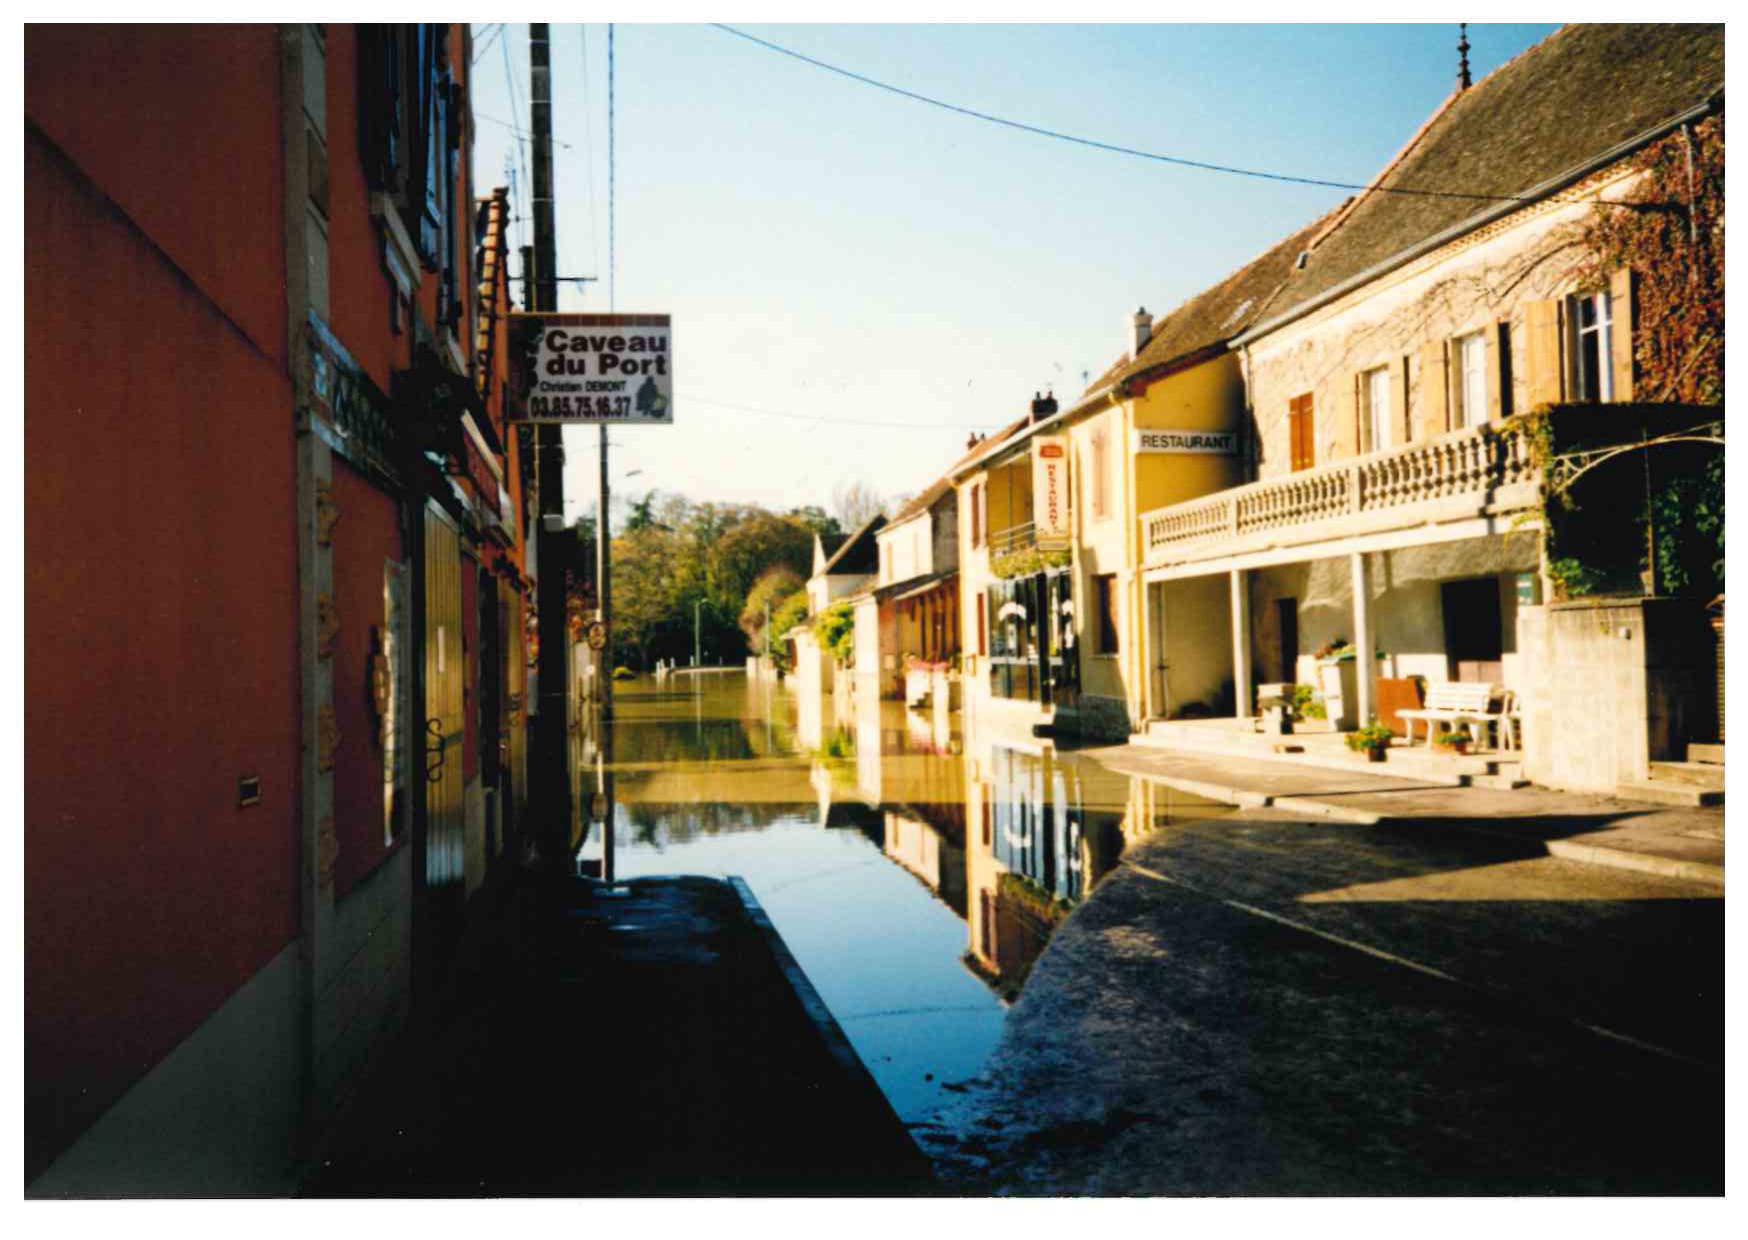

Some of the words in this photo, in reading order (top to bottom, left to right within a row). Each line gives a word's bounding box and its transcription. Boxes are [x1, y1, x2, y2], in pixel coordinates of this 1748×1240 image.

[545, 329, 667, 353] Caveau
[545, 353, 586, 375] du
[598, 353, 667, 375] Port
[540, 380, 583, 392] Christian
[530, 396, 631, 418] 03.85.75.16.37
[1141, 434, 1232, 450] RESTAURANT
[1047, 463, 1058, 526] RESTAURANT
